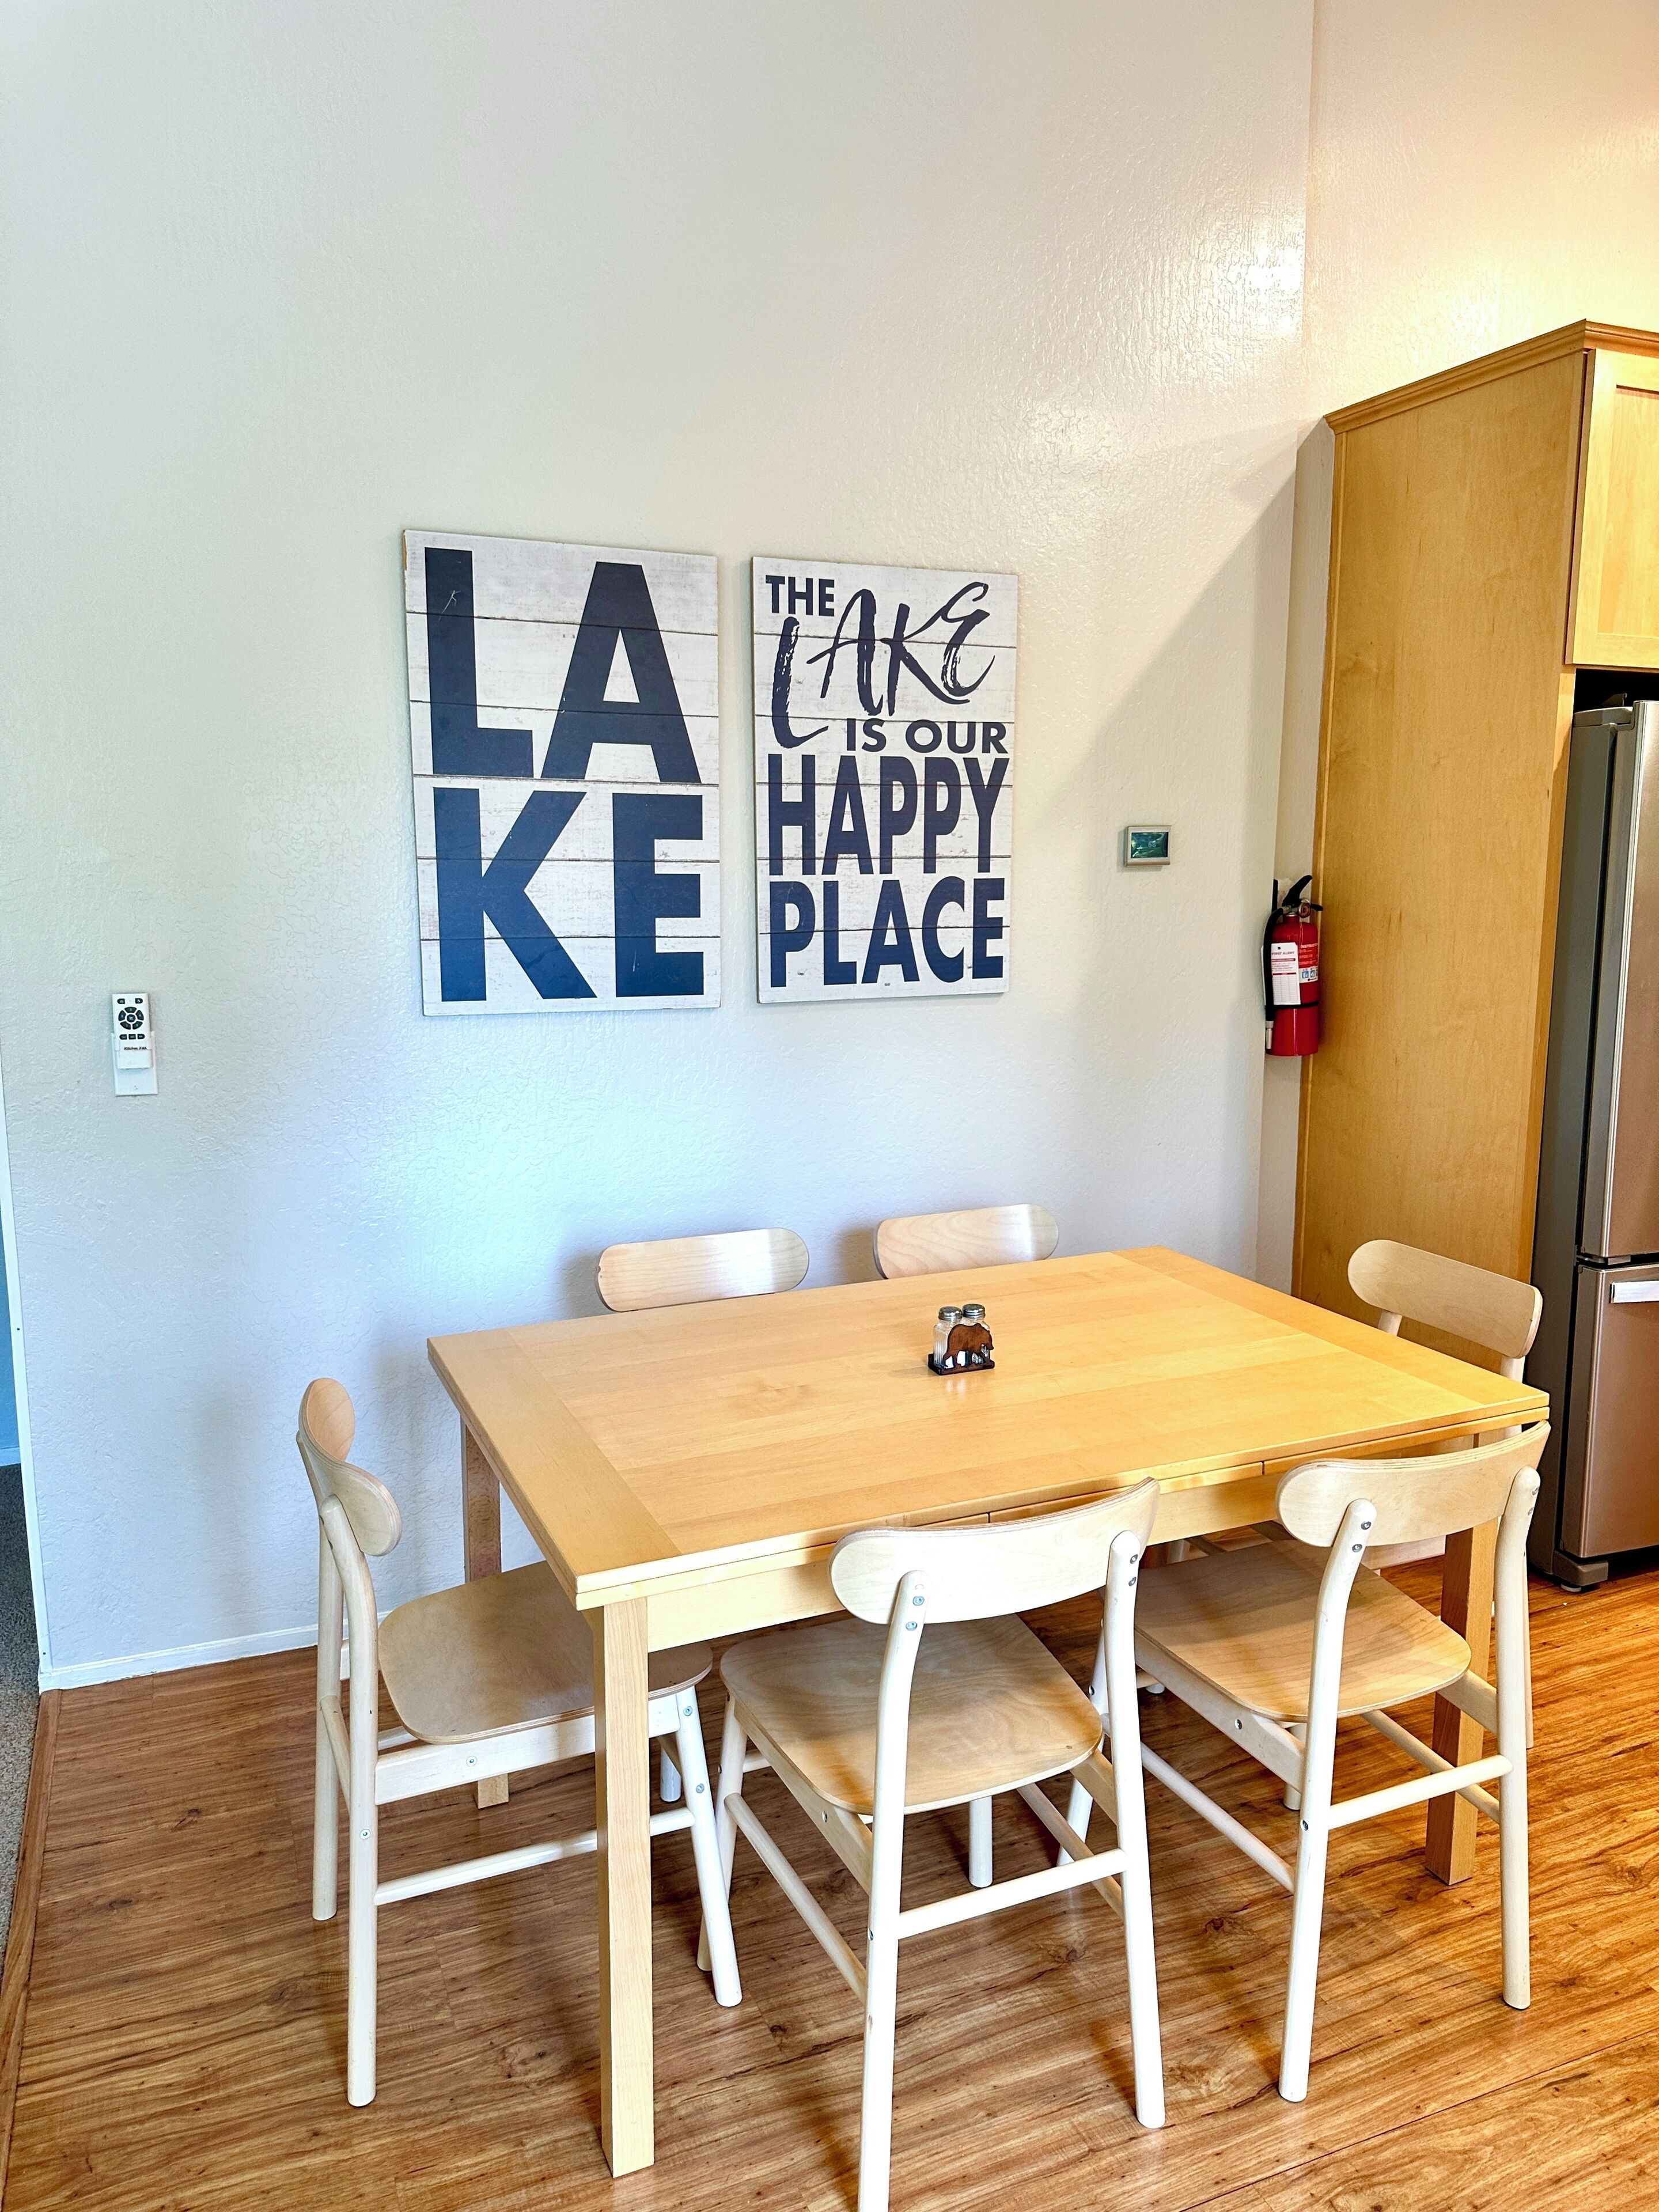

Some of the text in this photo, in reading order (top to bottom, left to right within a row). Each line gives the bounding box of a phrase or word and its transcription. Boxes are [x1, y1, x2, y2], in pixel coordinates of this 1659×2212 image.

[765, 574, 835, 617] THE
[425, 547, 702, 783] LA
[771, 581, 995, 749] LAKE
[846, 718, 1009, 755] IS OUR
[768, 753, 1010, 876] HAPPY
[433, 786, 704, 1002] KE
[769, 876, 1005, 988] PLACE
